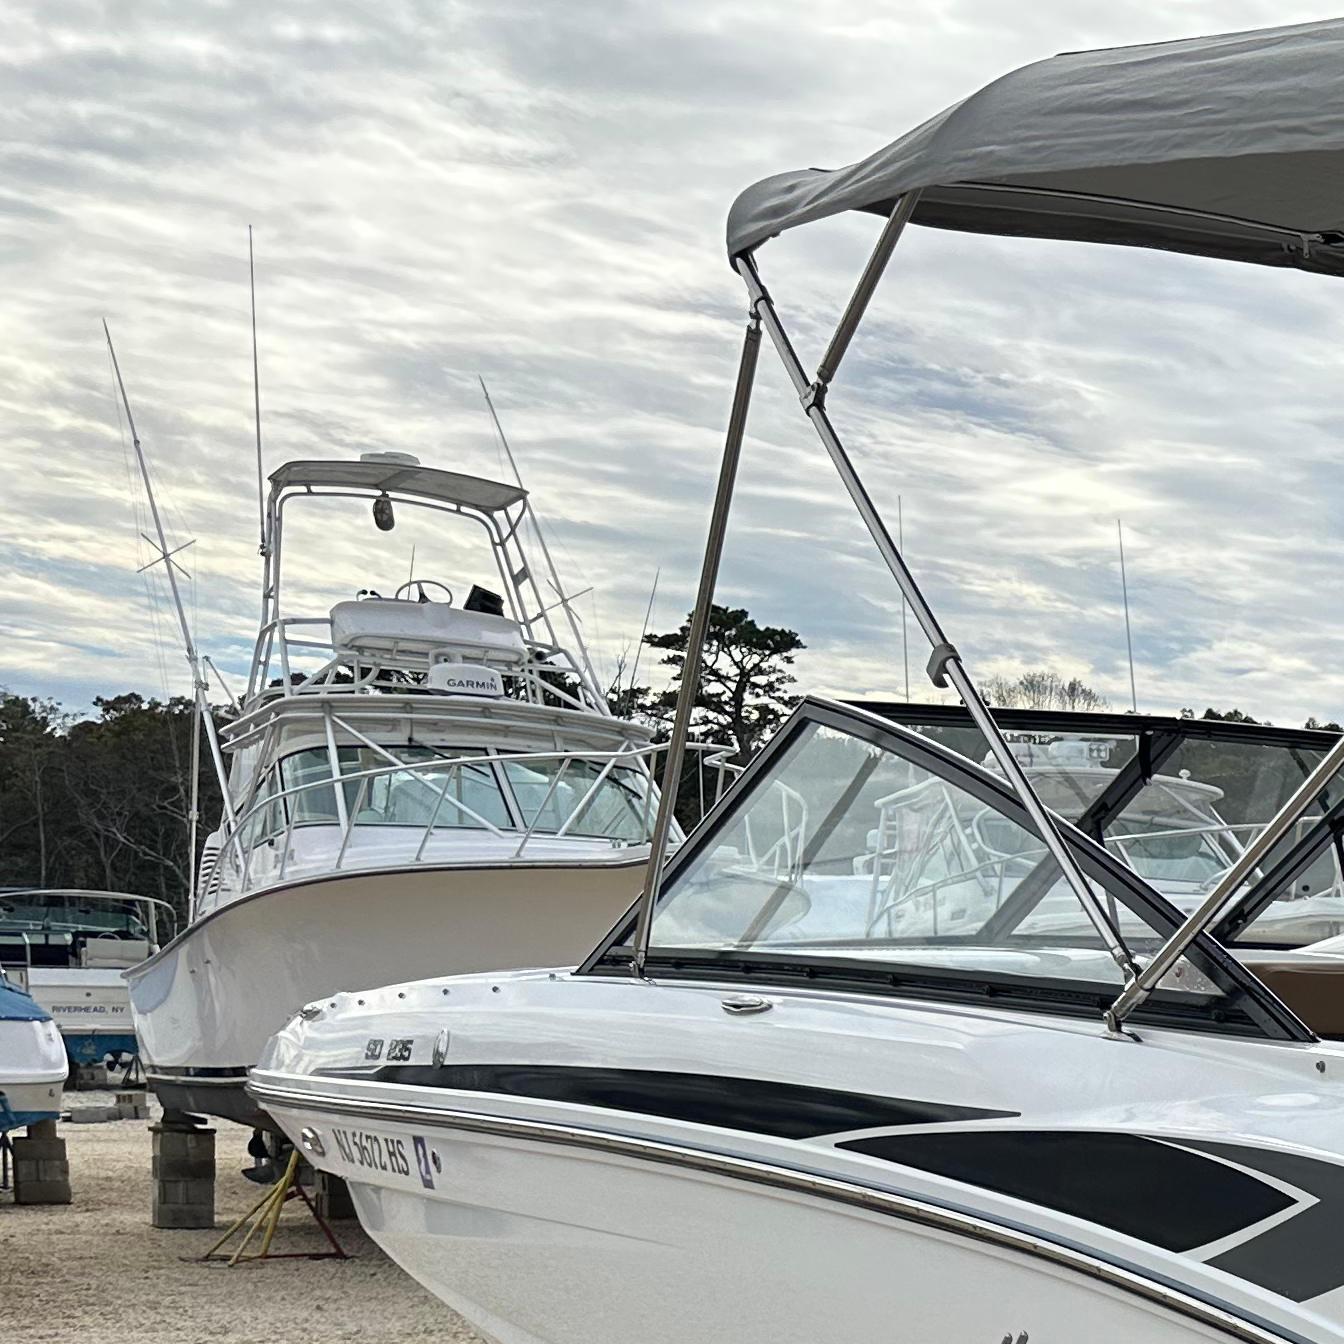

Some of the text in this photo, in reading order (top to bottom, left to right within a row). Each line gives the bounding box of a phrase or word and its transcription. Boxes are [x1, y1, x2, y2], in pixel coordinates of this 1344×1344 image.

[447, 678, 498, 691] GARMIN
[332, 1128, 410, 1176] NJ 5672 HS
